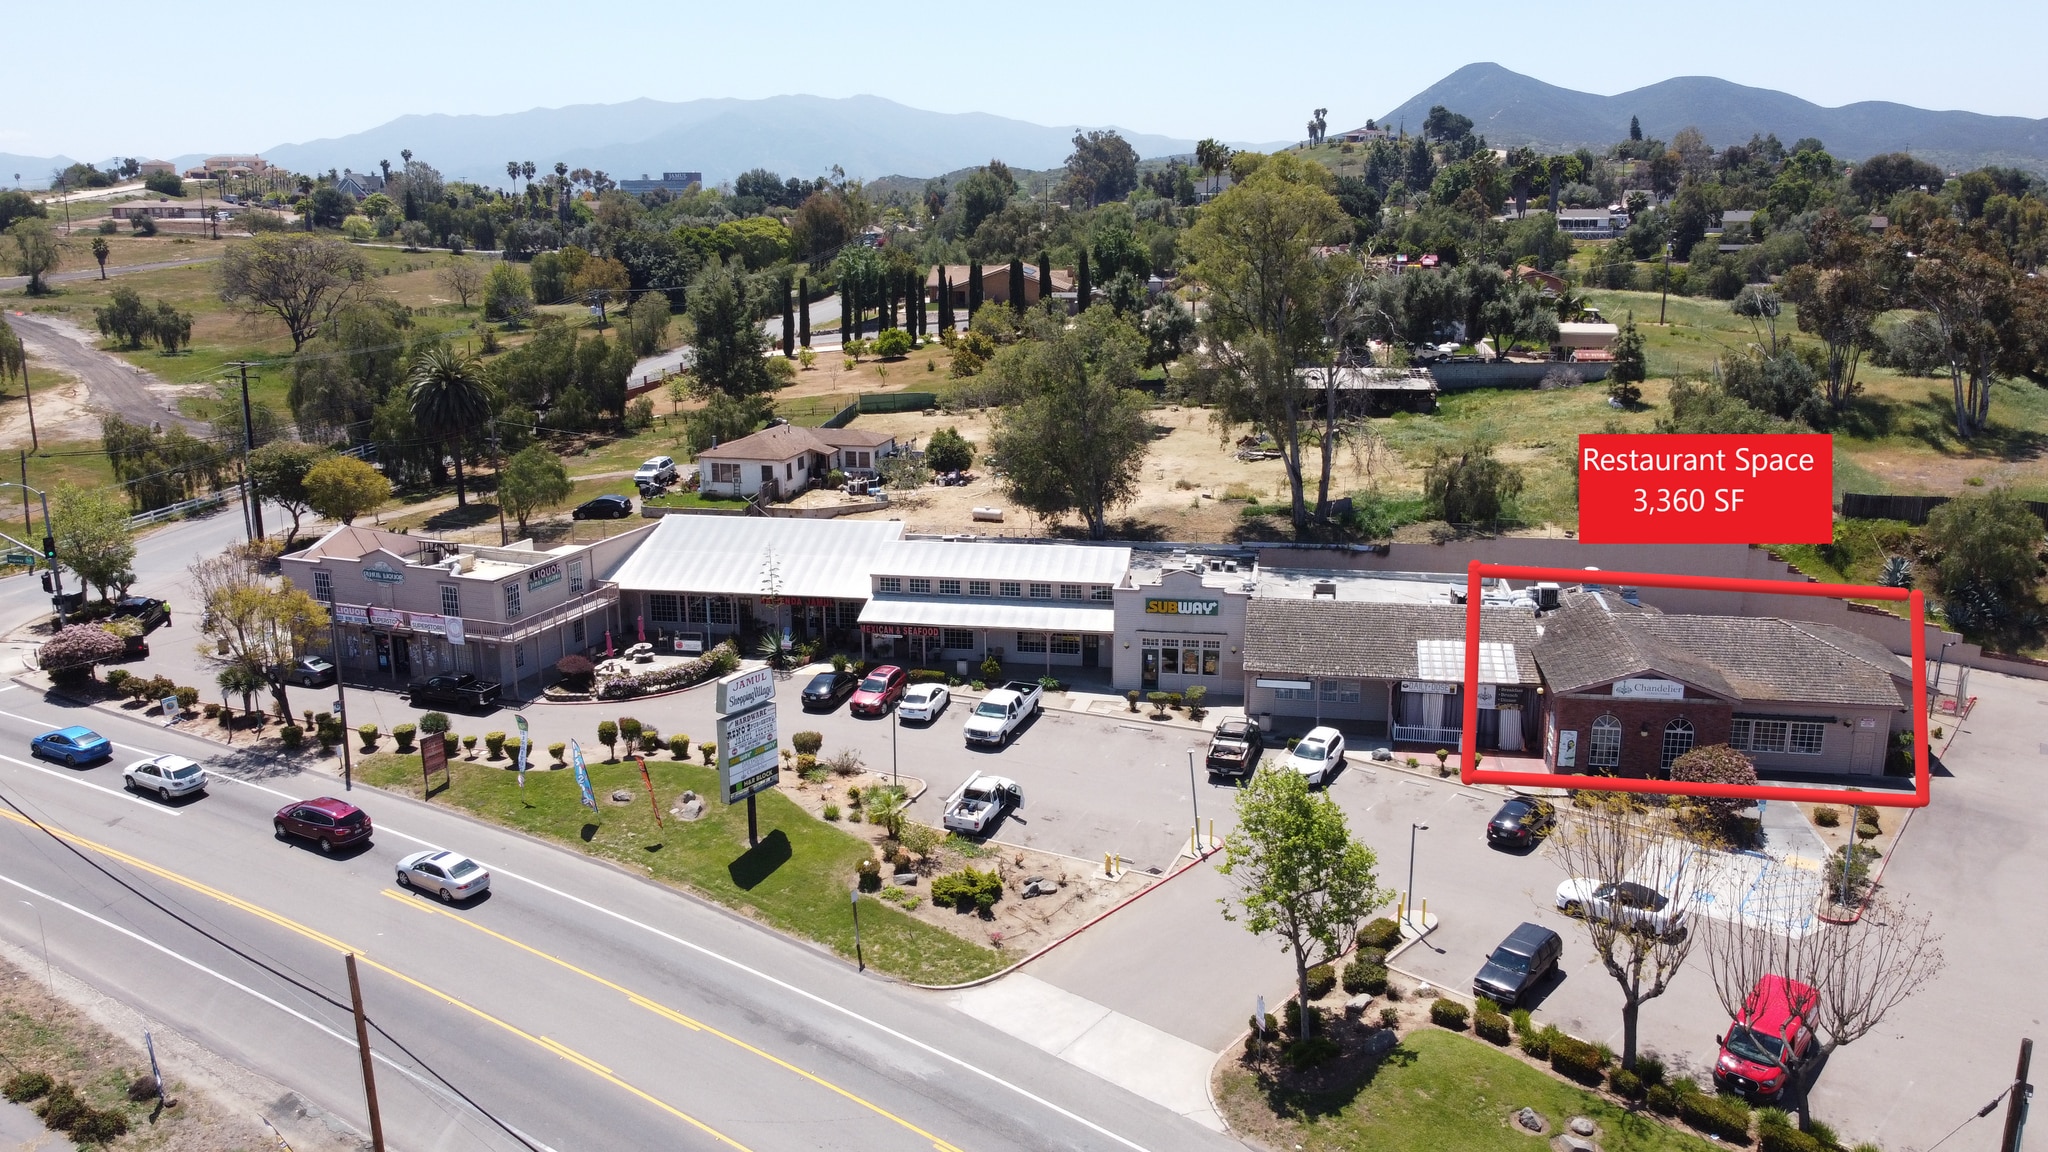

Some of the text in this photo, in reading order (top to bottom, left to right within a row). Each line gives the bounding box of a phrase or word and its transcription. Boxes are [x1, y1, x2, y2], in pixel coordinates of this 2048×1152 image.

[533, 564, 562, 580] LIQUOR
[805, 597, 835, 607] JAMUL
[1146, 600, 1218, 615] SUBWAY
[336, 607, 367, 616] LIQUOR
[861, 624, 939, 636] MEXICAN & SEAFOOD
[732, 671, 768, 692] JAMUL
[1409, 682, 1449, 692] DAILY DOSE
[1634, 683, 1683, 693] Chandelier
[729, 684, 773, 708] Shopping Village
[734, 708, 767, 727] HARDWARE
[756, 769, 773, 782] BLOCK
